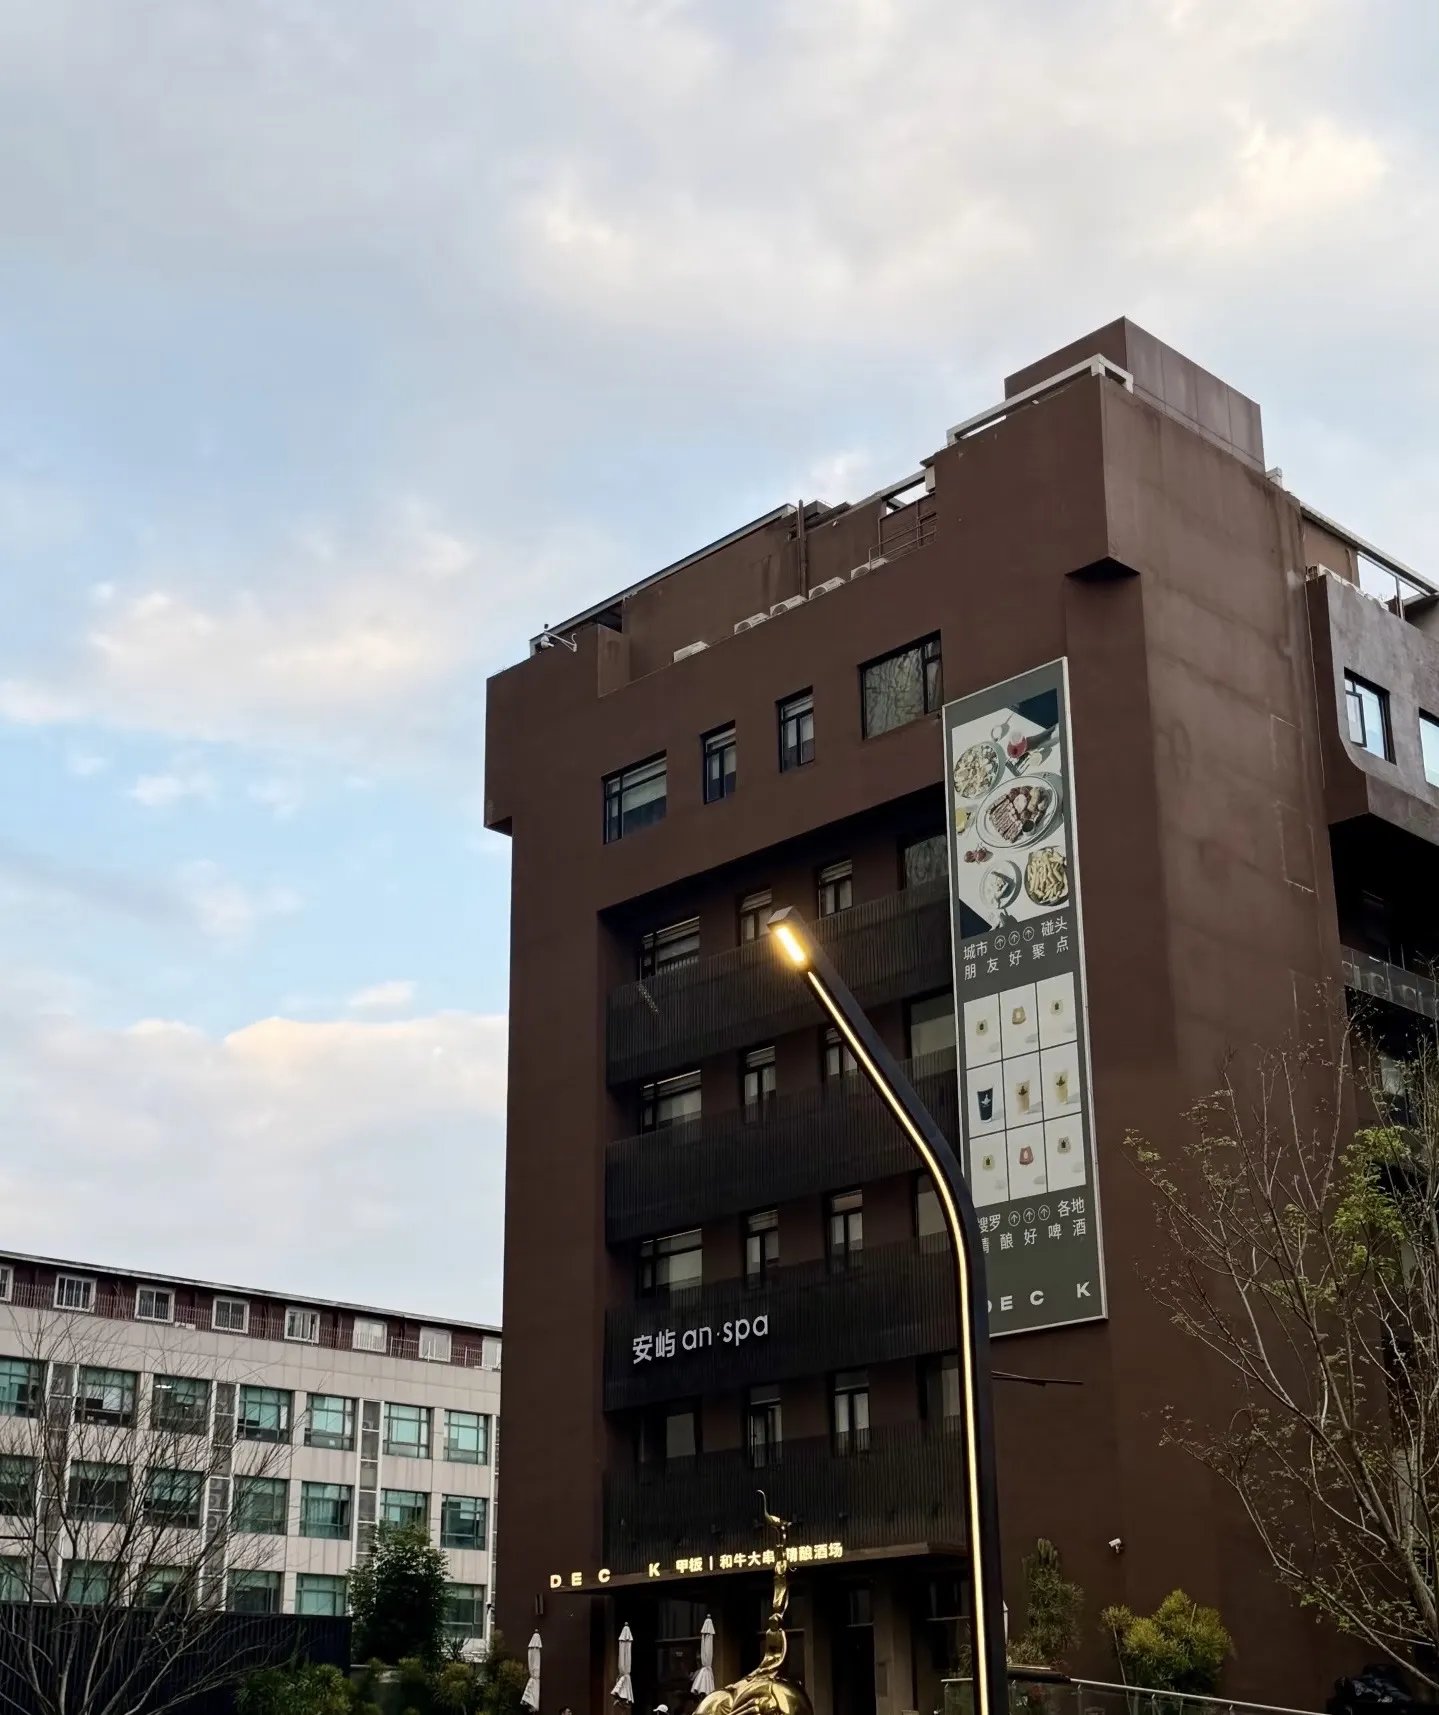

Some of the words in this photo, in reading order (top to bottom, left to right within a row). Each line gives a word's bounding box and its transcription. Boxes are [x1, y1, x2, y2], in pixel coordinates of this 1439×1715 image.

[963, 940, 988, 960] 城市
[1041, 915, 1068, 937] 碰头
[1057, 1196, 1086, 1218] 各地
[632, 1328, 677, 1365] 安屿
[675, 1556, 703, 1574] 甲板
